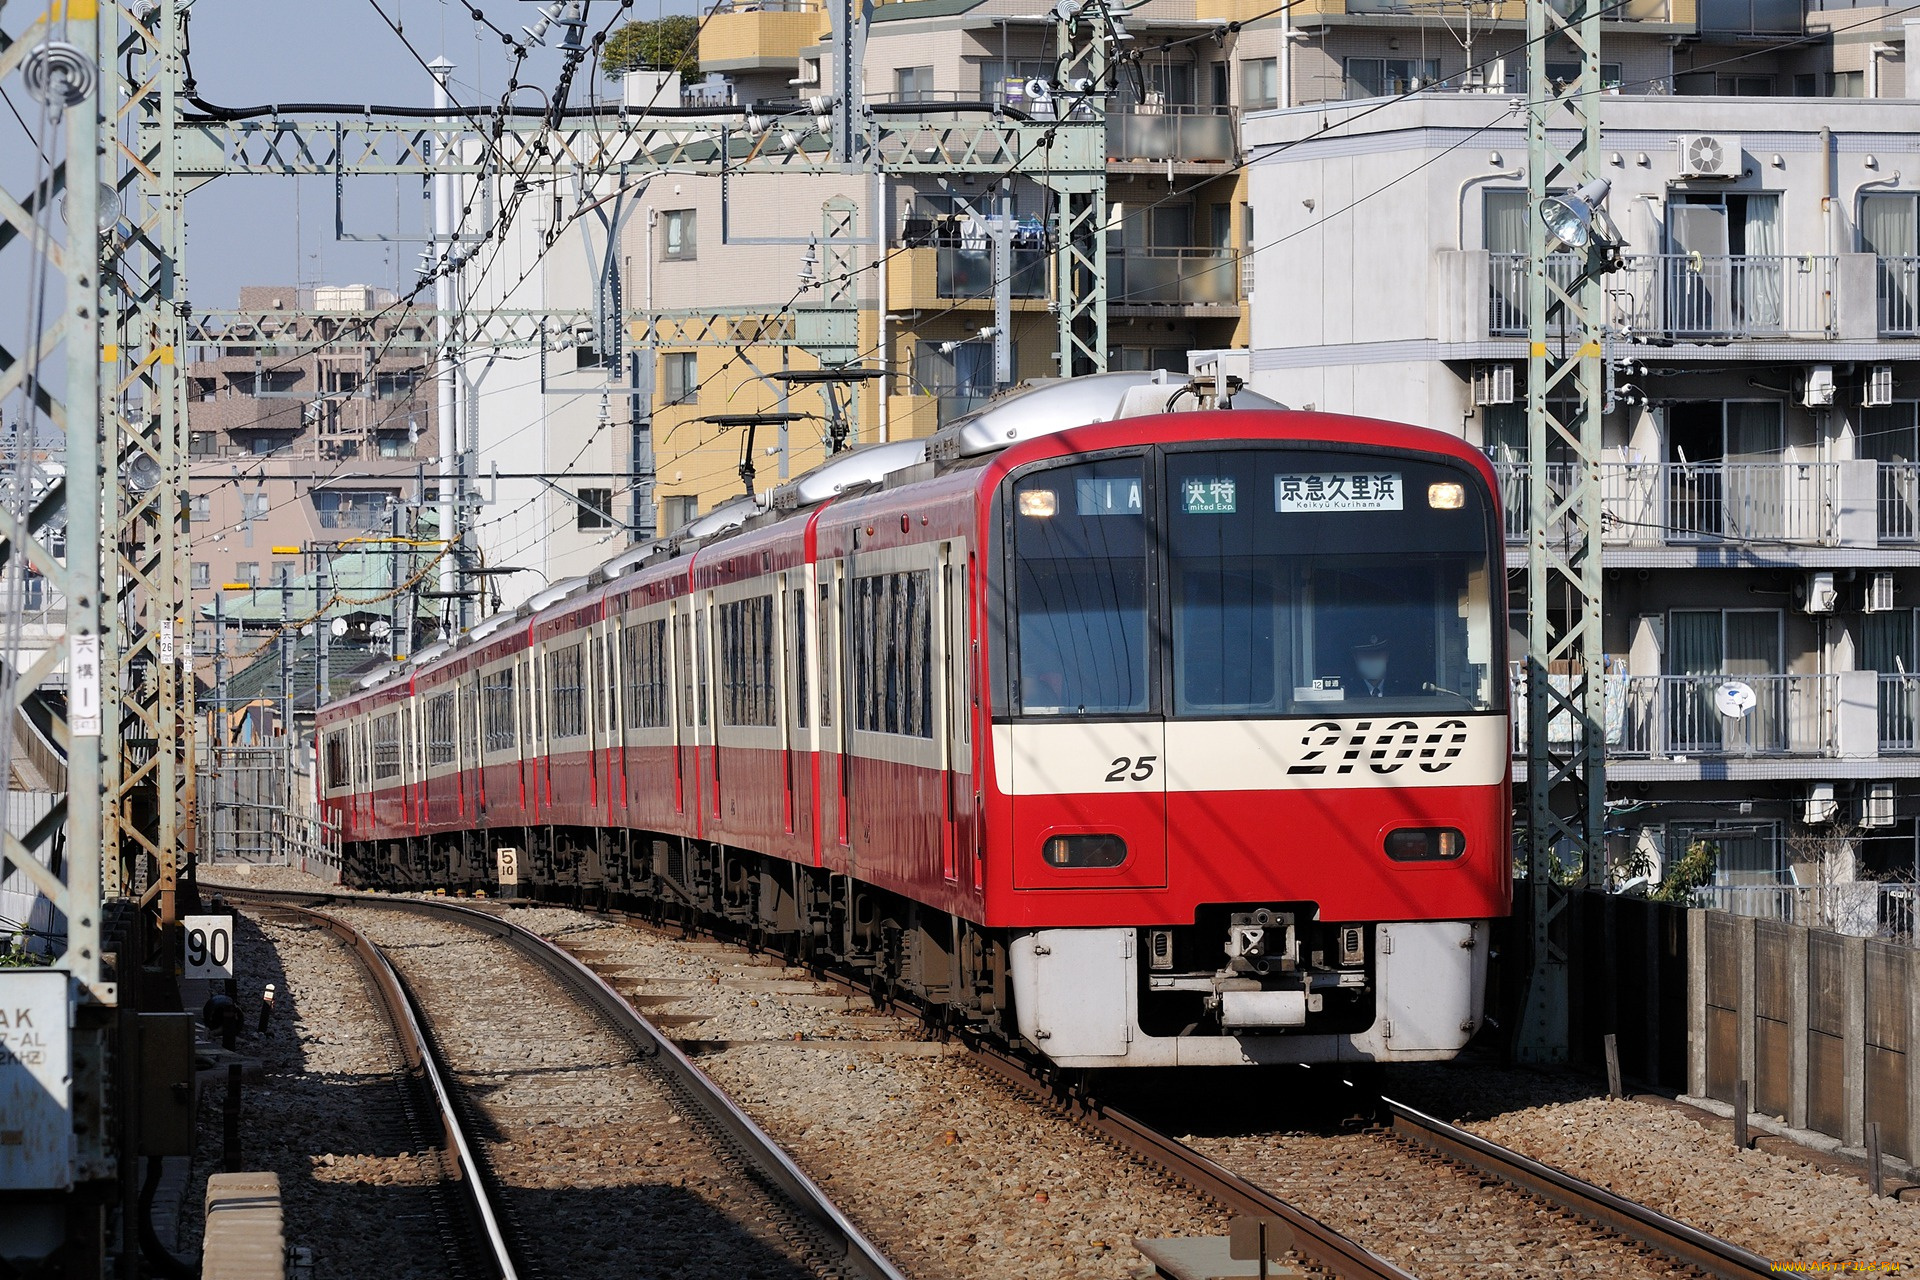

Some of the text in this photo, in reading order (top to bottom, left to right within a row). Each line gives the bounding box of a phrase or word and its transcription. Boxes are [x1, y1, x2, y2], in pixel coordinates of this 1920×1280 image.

[1127, 481, 1142, 509] A
[1181, 477, 1234, 504] 快特
[1281, 475, 1394, 501] 京急久里浜
[1216, 502, 1234, 512] Exp.
[1334, 500, 1381, 508] Kurihama
[1313, 681, 1322, 689] 12
[1286, 719, 1469, 775] 2100
[1104, 756, 1157, 782] 25
[501, 850, 513, 864] 5
[502, 865, 513, 876] 10
[187, 928, 229, 967] 90
